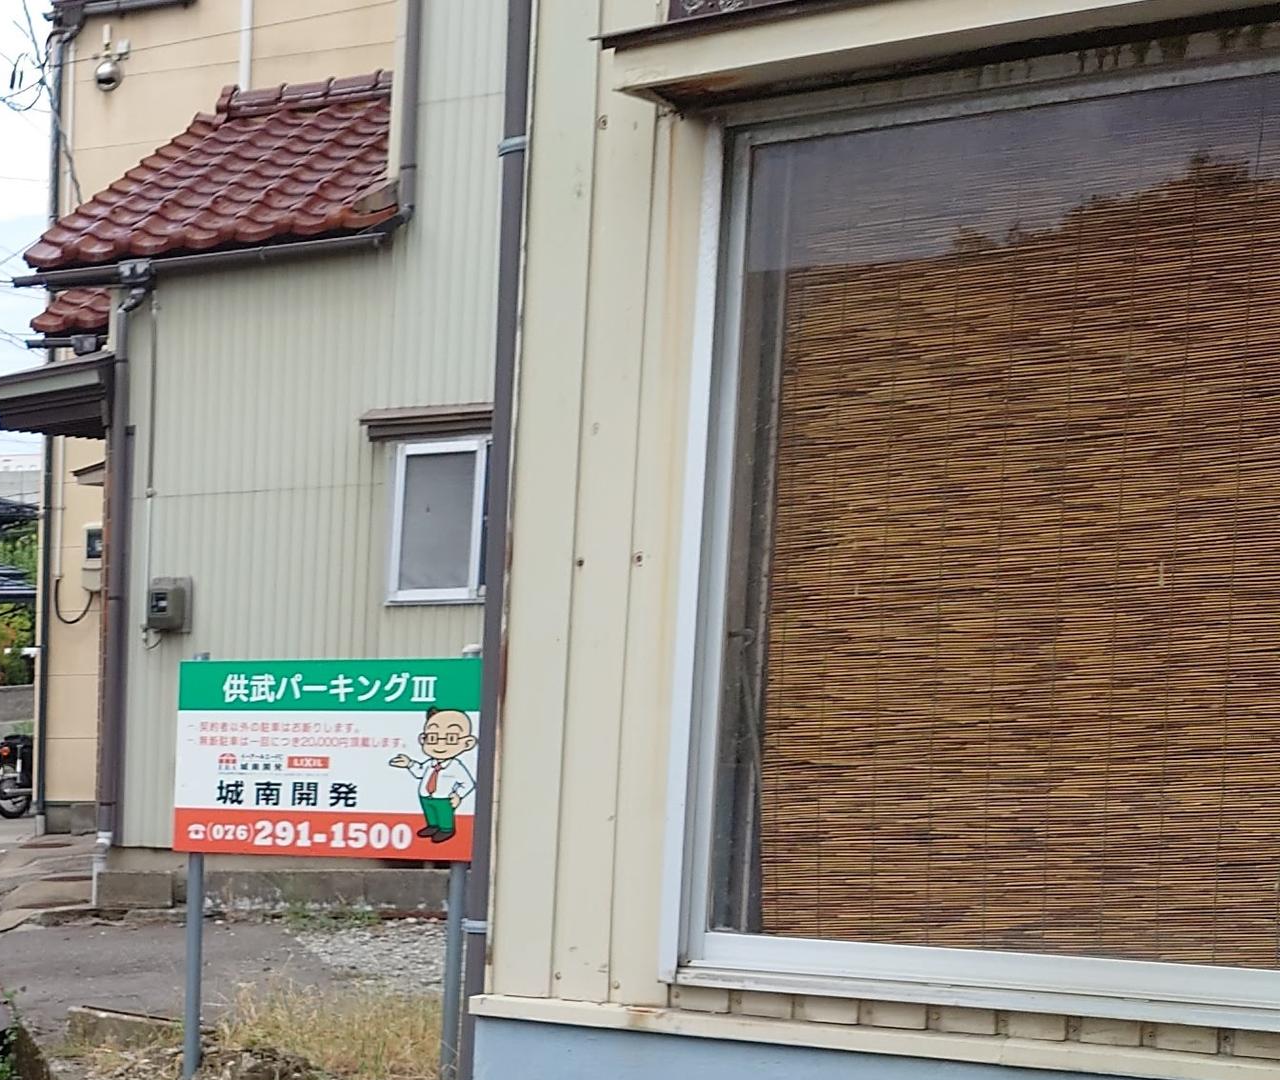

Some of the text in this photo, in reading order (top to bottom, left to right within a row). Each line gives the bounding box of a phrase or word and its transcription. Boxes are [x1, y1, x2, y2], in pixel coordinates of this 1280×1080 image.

[292, 758, 324, 768] LIXIL
[217, 779, 359, 808] 城南開発
